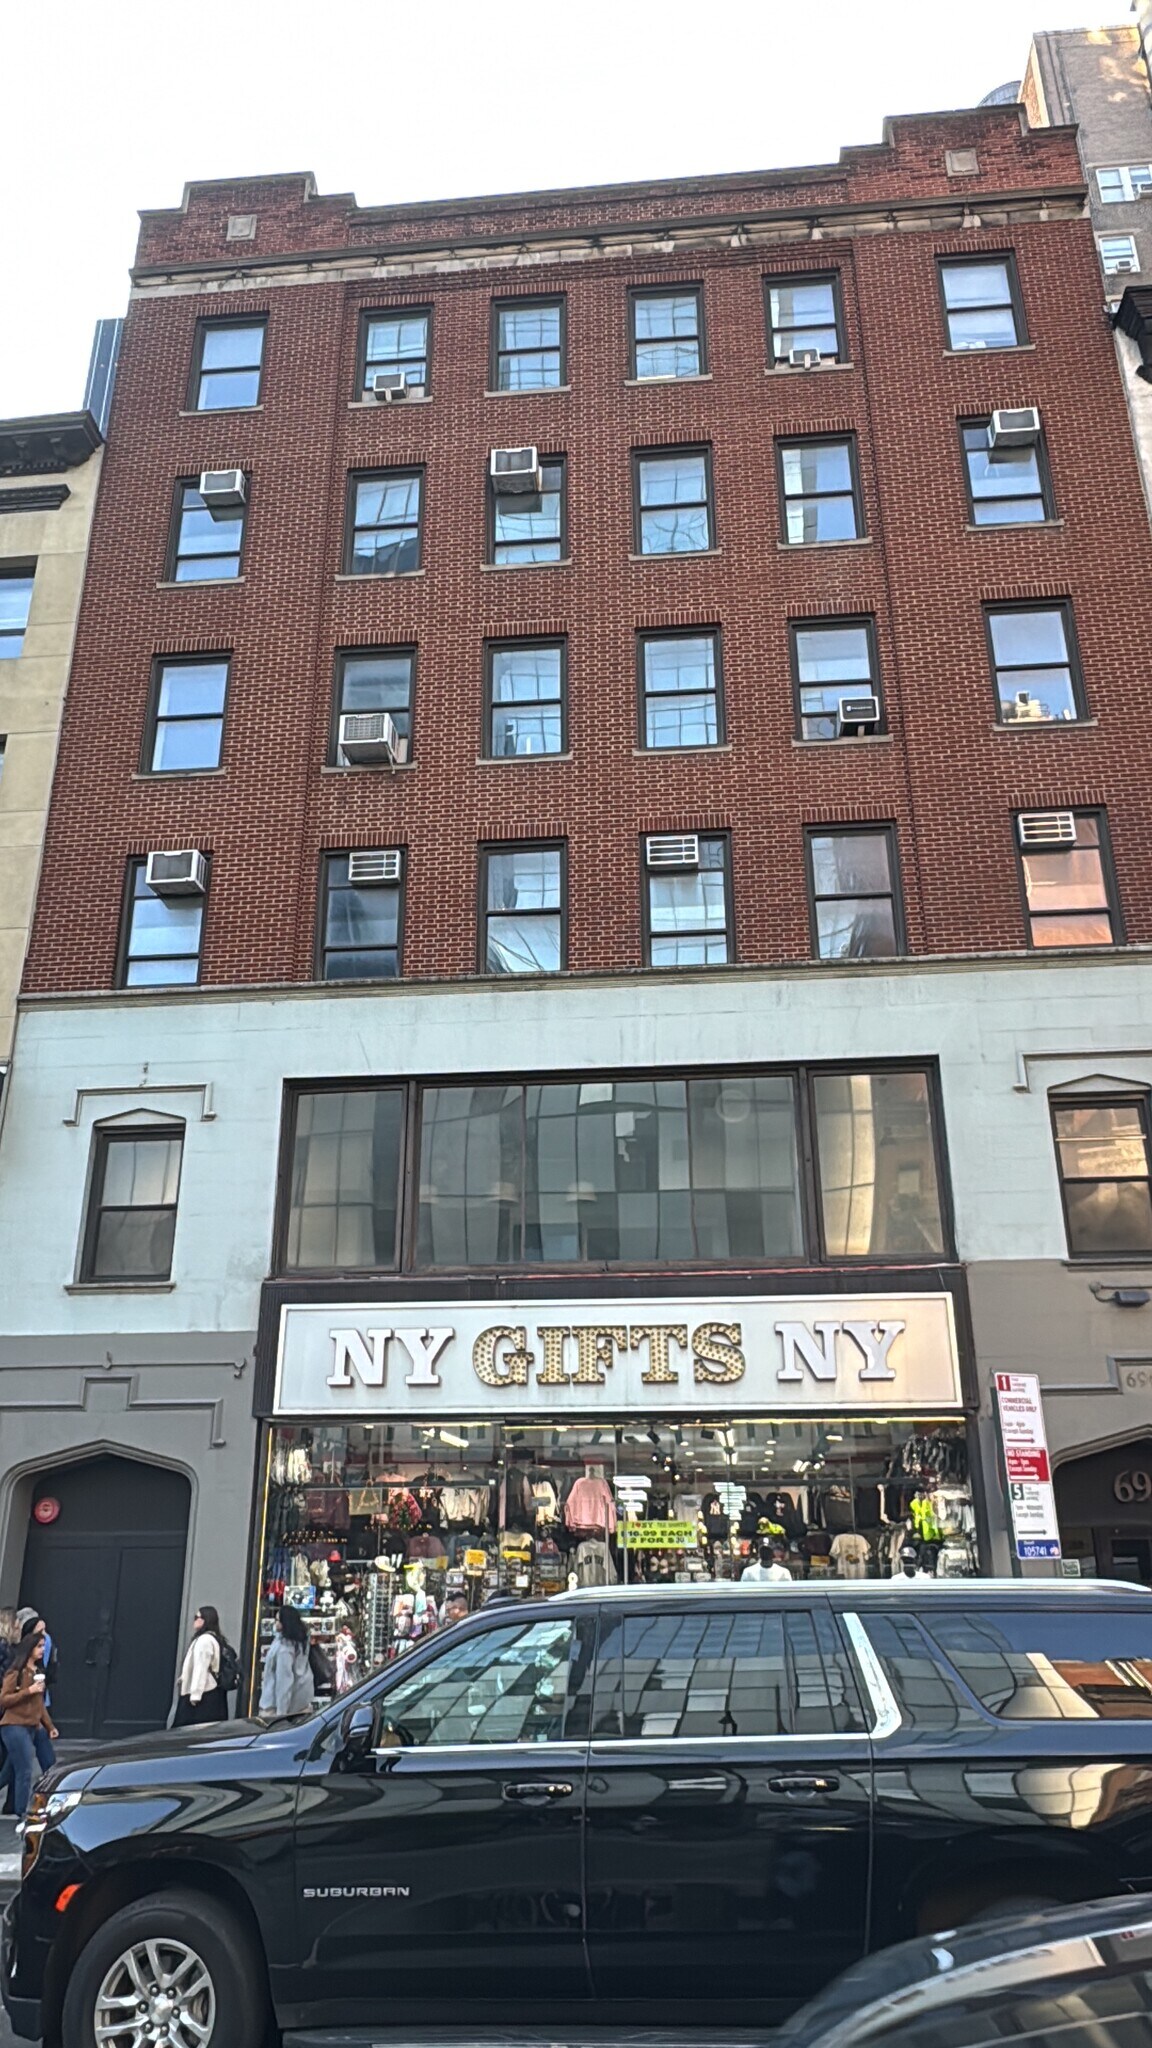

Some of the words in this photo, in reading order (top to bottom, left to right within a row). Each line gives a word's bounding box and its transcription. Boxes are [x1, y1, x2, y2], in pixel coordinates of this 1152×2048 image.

[326, 1327, 454, 1387] NY
[472, 1322, 746, 1388] GIFTS
[774, 1320, 906, 1383] NY
[1014, 1483, 1022, 1500] 5
[303, 1887, 410, 1898] SUBURBAN
